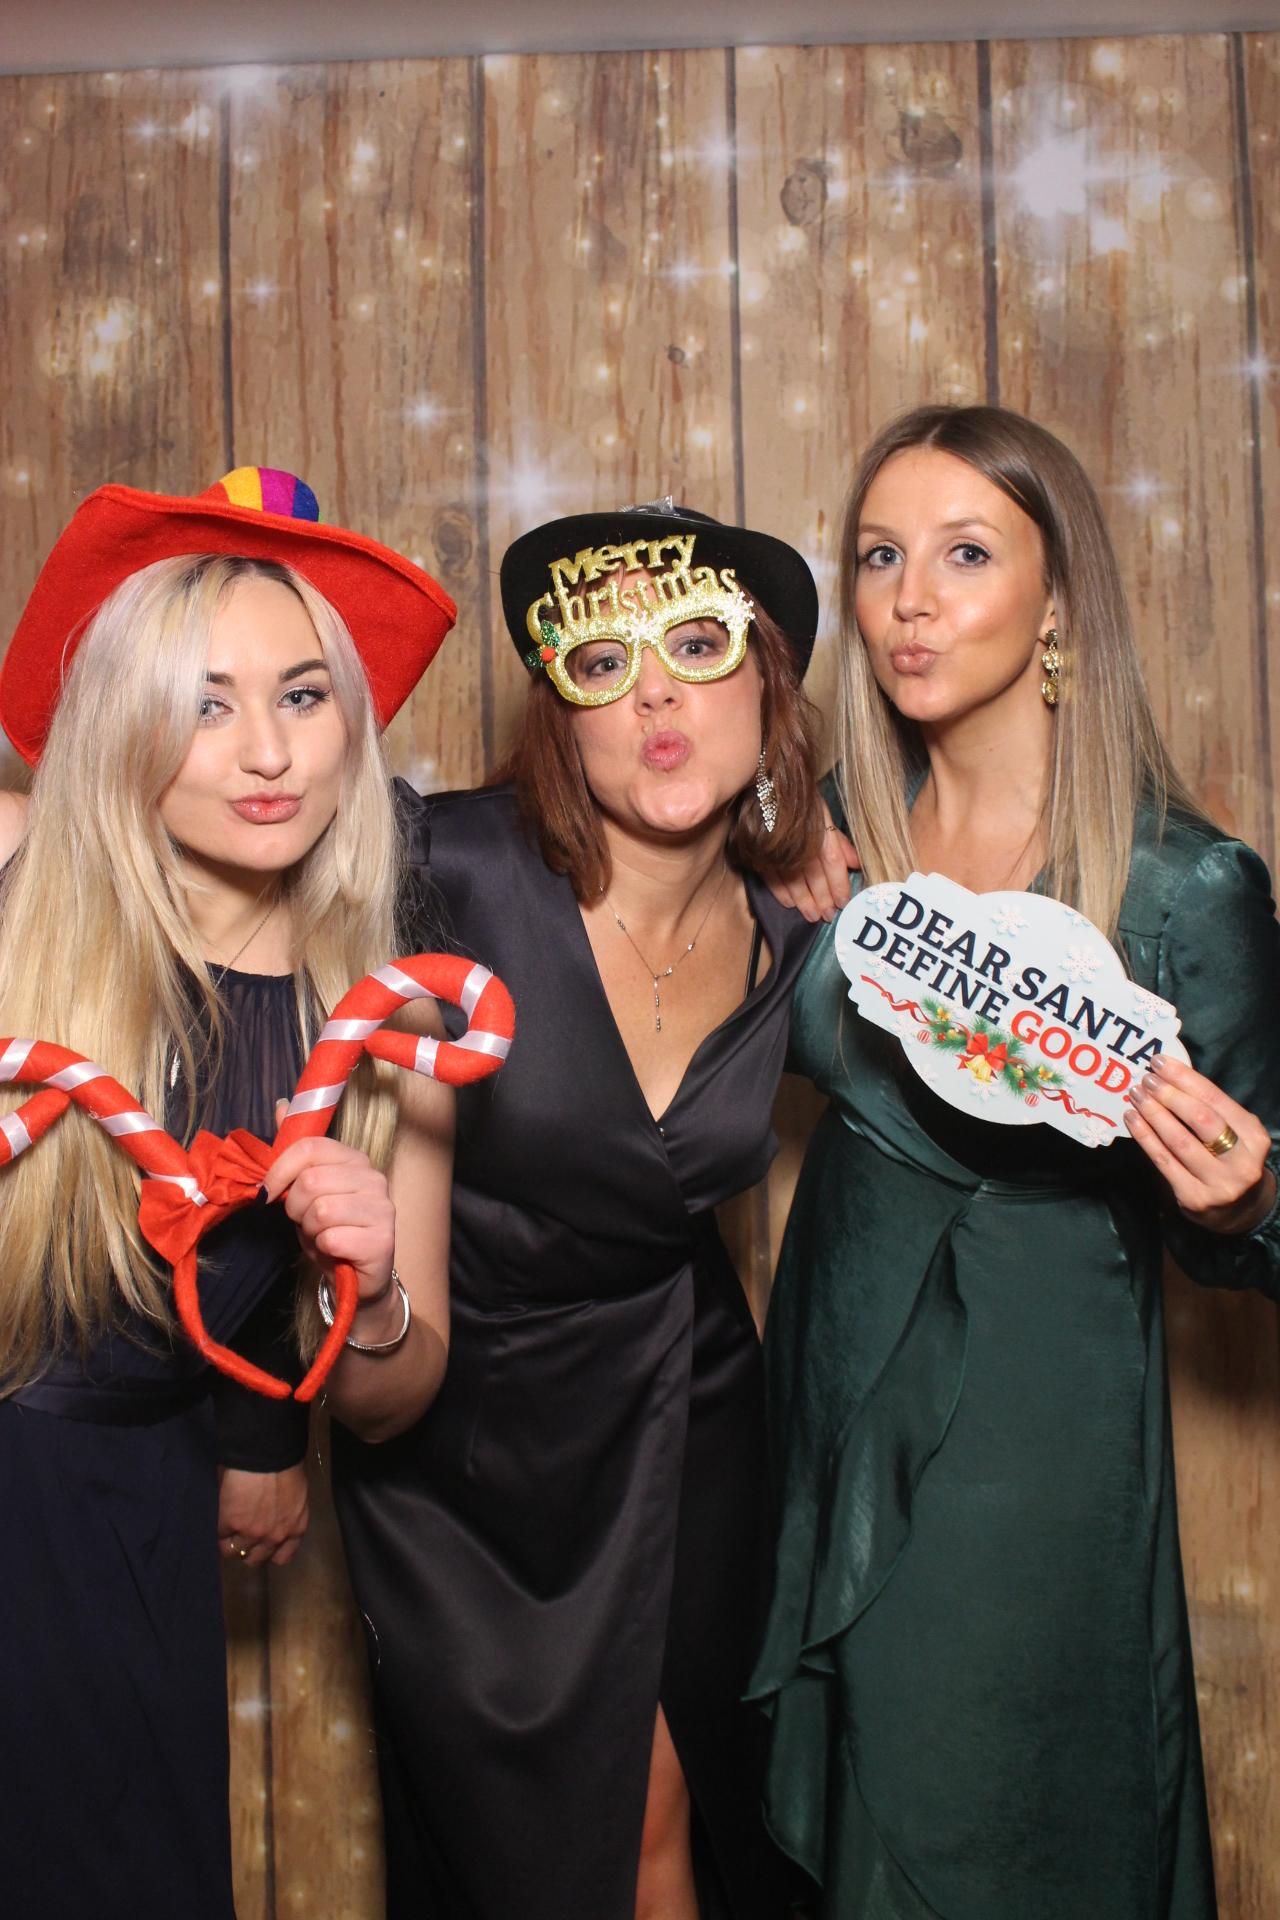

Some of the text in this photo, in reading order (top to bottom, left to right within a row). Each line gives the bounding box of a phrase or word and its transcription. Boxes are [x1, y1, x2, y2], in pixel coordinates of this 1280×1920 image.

[526, 566, 742, 645] Christmas
[548, 534, 697, 593] Merry
[852, 916, 1010, 1026] DEFINE
[886, 891, 1166, 1073] DEAR SANTA
